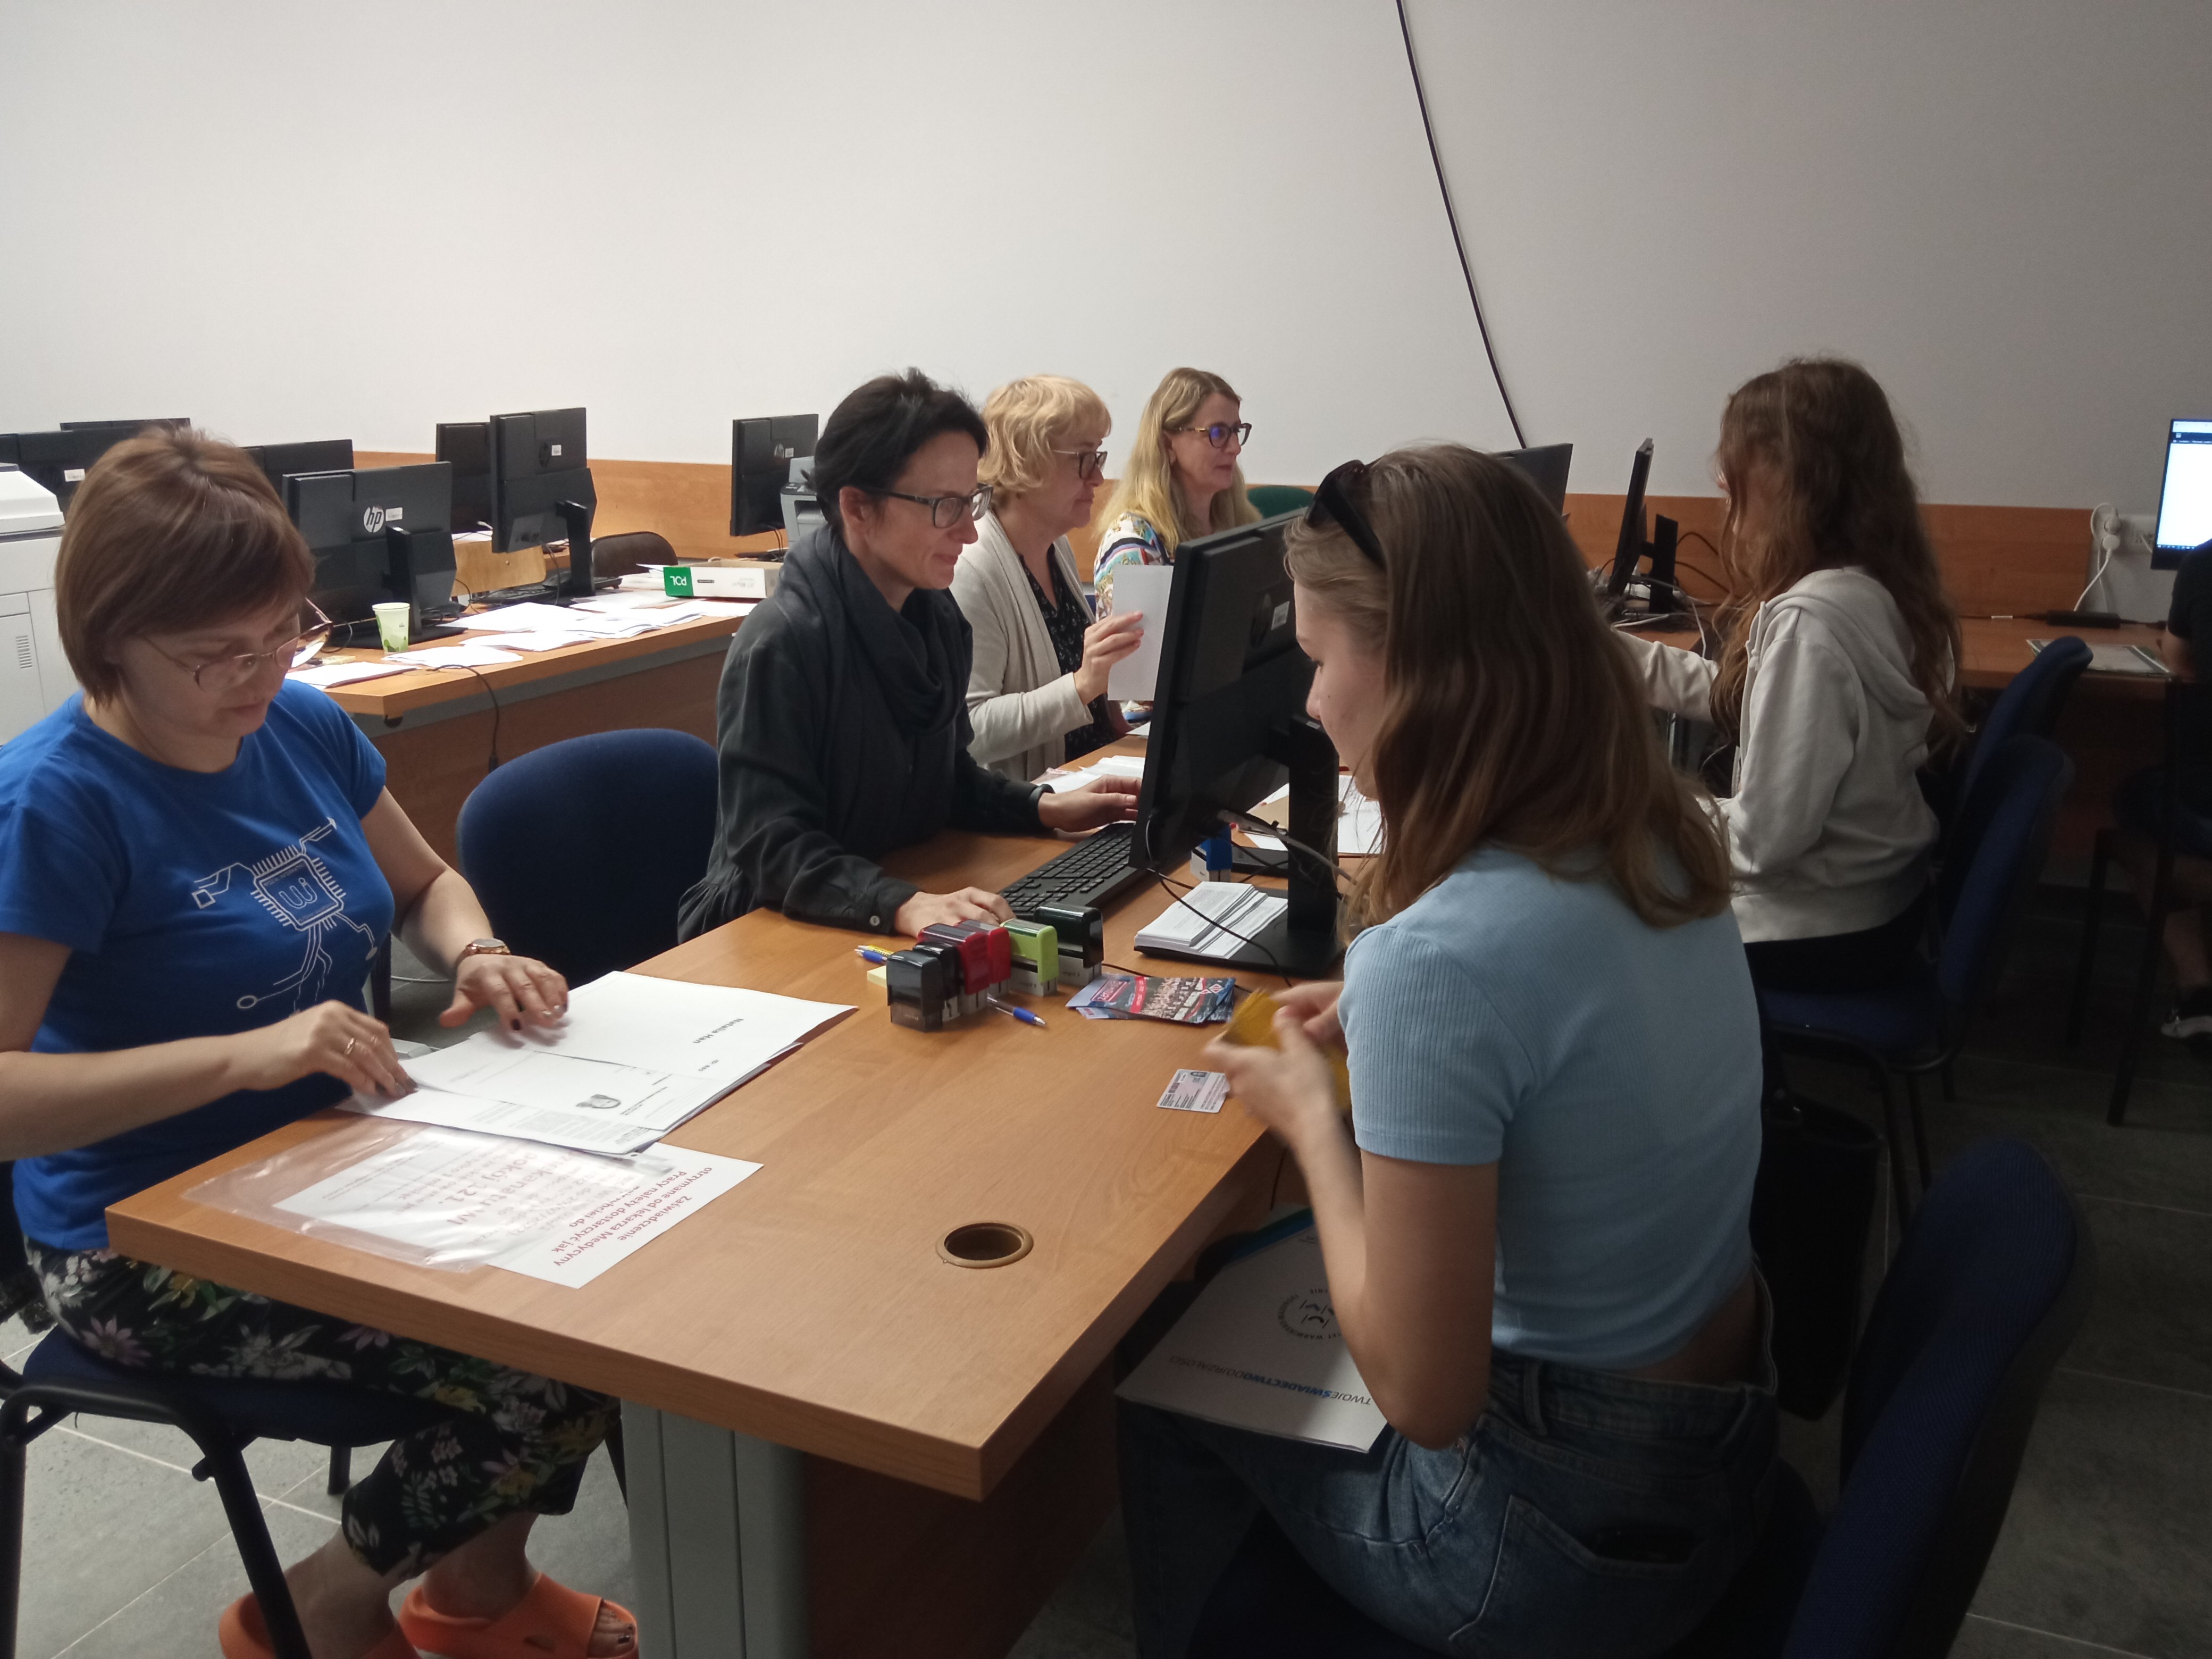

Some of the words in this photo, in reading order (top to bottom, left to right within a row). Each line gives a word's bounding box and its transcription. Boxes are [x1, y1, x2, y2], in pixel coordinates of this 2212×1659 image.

[365, 506, 383, 532] hp
[711, 1018, 744, 1033] Natalia
[656, 1171, 687, 1187] Pracy
[661, 1167, 712, 1197] otrzymane
[438, 1183, 487, 1204] 121.
[624, 1187, 658, 1207] należy
[647, 1199, 662, 1208] od
[569, 1218, 584, 1227] do
[569, 1208, 625, 1241] dostarczyć
[610, 1208, 651, 1230] lekarza
[617, 1196, 691, 1240] Zaświadczenie
[551, 1241, 573, 1252] jak
[554, 1231, 613, 1266] Medycyny
